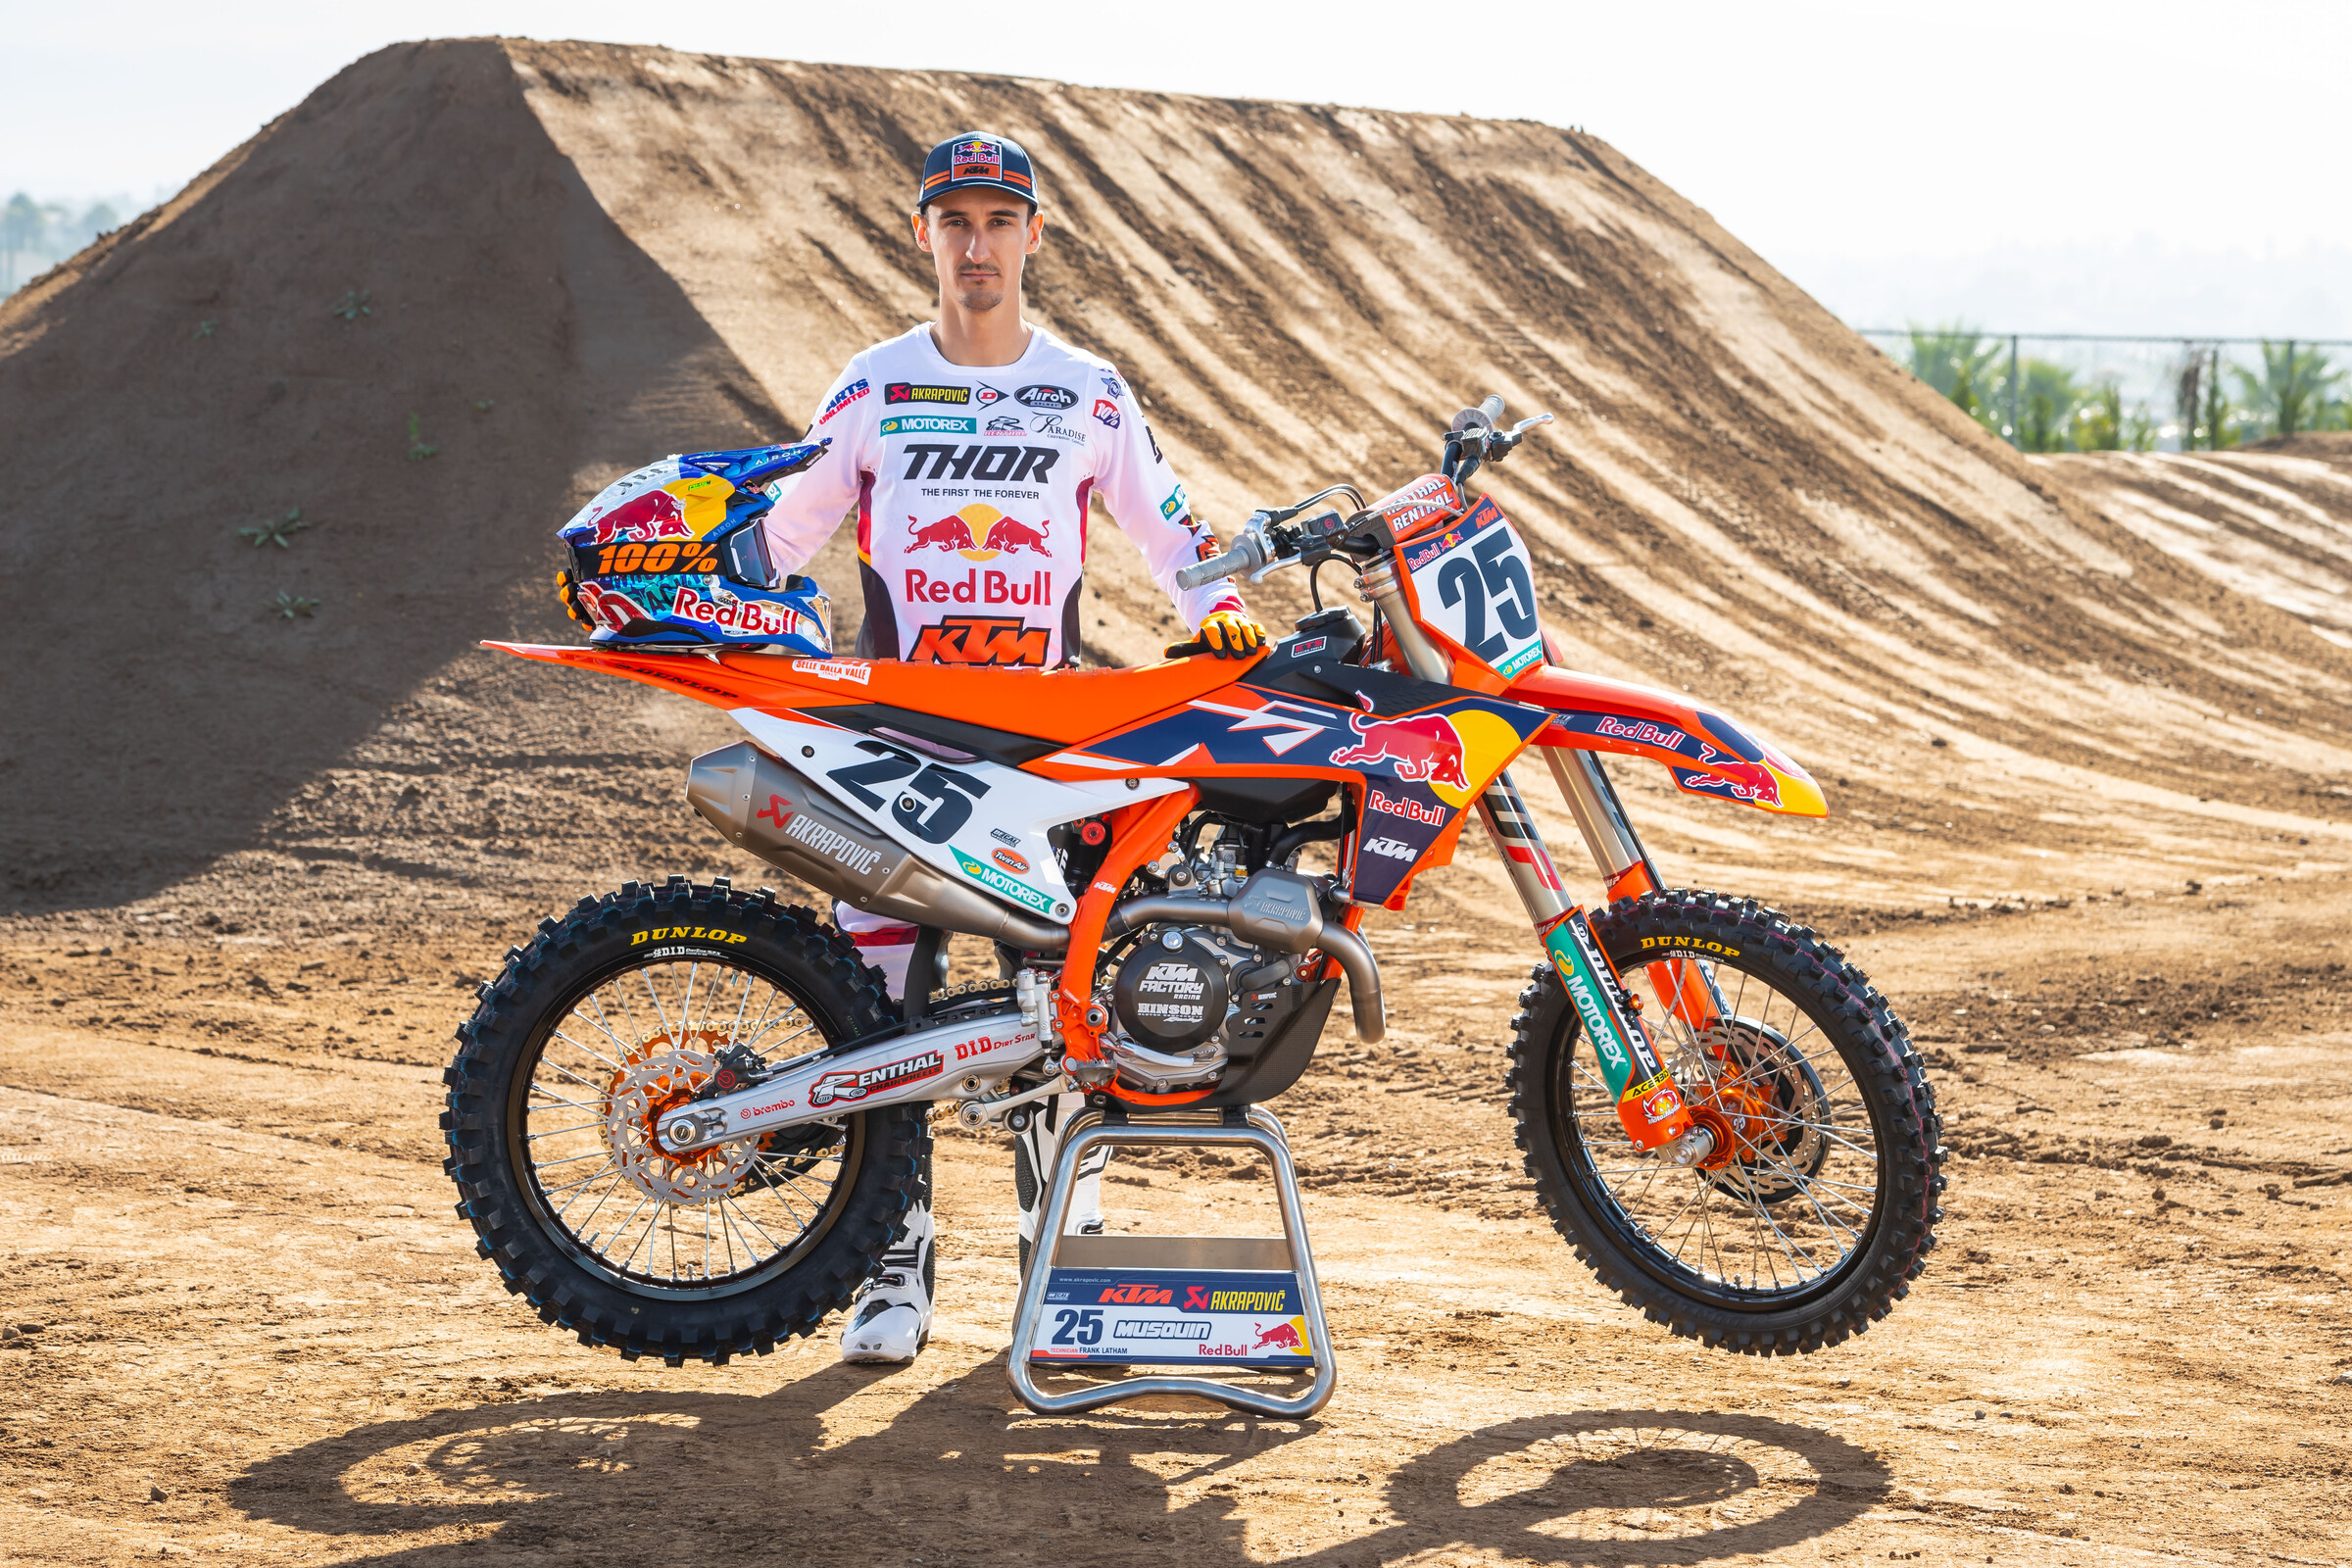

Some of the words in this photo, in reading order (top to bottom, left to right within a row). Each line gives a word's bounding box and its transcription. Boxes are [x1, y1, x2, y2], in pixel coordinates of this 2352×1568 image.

[955, 153, 976, 165] Red
[978, 153, 999, 164] Bull
[963, 166, 989, 174] KTM
[819, 387, 870, 424] UNLIMITED
[1020, 388, 1071, 404] Airoh
[902, 418, 969, 431] MOTOREX
[755, 449, 802, 466] AIROH
[903, 444, 1060, 483] THOR
[921, 488, 940, 497] THE
[974, 489, 993, 498] THE
[995, 489, 1040, 500] FOREVER
[712, 518, 737, 537] AIROH
[1475, 506, 1498, 529] KTM
[598, 543, 718, 574] 100%
[1407, 550, 1426, 570] Red
[1423, 542, 1441, 564] Bull
[905, 568, 976, 603] Red
[984, 570, 1052, 606] Bull
[1437, 526, 1539, 663] 25
[670, 585, 738, 627] Red
[740, 601, 801, 636] Bull
[908, 616, 1051, 666] KTM
[1295, 639, 1323, 652] ETS
[1511, 646, 1542, 671] MOTOREX
[796, 660, 818, 670] SELLE
[819, 663, 843, 675] DALLA
[845, 667, 867, 681] VALLE
[633, 667, 740, 698] DUNLOP
[1595, 716, 1640, 741] Red
[1637, 725, 1687, 750] Bull
[826, 739, 992, 845] 25
[1368, 790, 1408, 817] Red
[1406, 800, 1446, 827] Bull
[786, 812, 883, 876] AKRAPOVIČ
[1363, 836, 1418, 862] KTM
[994, 851, 1015, 865] Twin
[1013, 860, 1029, 872] Air
[981, 867, 1049, 909] MOTOREX
[1094, 881, 1117, 894] KTM
[630, 926, 748, 946] DUNLOP
[1641, 936, 1740, 957] DUNLOP
[1146, 962, 1199, 982] KTM
[1139, 981, 1204, 994] FACTORY
[1137, 1003, 1204, 1015] HINSON
[1567, 975, 1627, 1070] MOTOREX
[955, 1036, 993, 1060] D.I.D
[869, 1066, 941, 1093] CHAINWHEELS
[753, 1100, 796, 1116] brembo
[1098, 1284, 1174, 1304] KTM
[1210, 1290, 1286, 1311] AKRAPOVIČ
[1052, 1308, 1104, 1346] 25
[1199, 1344, 1223, 1356] Red
[1224, 1344, 1248, 1356] Bull
